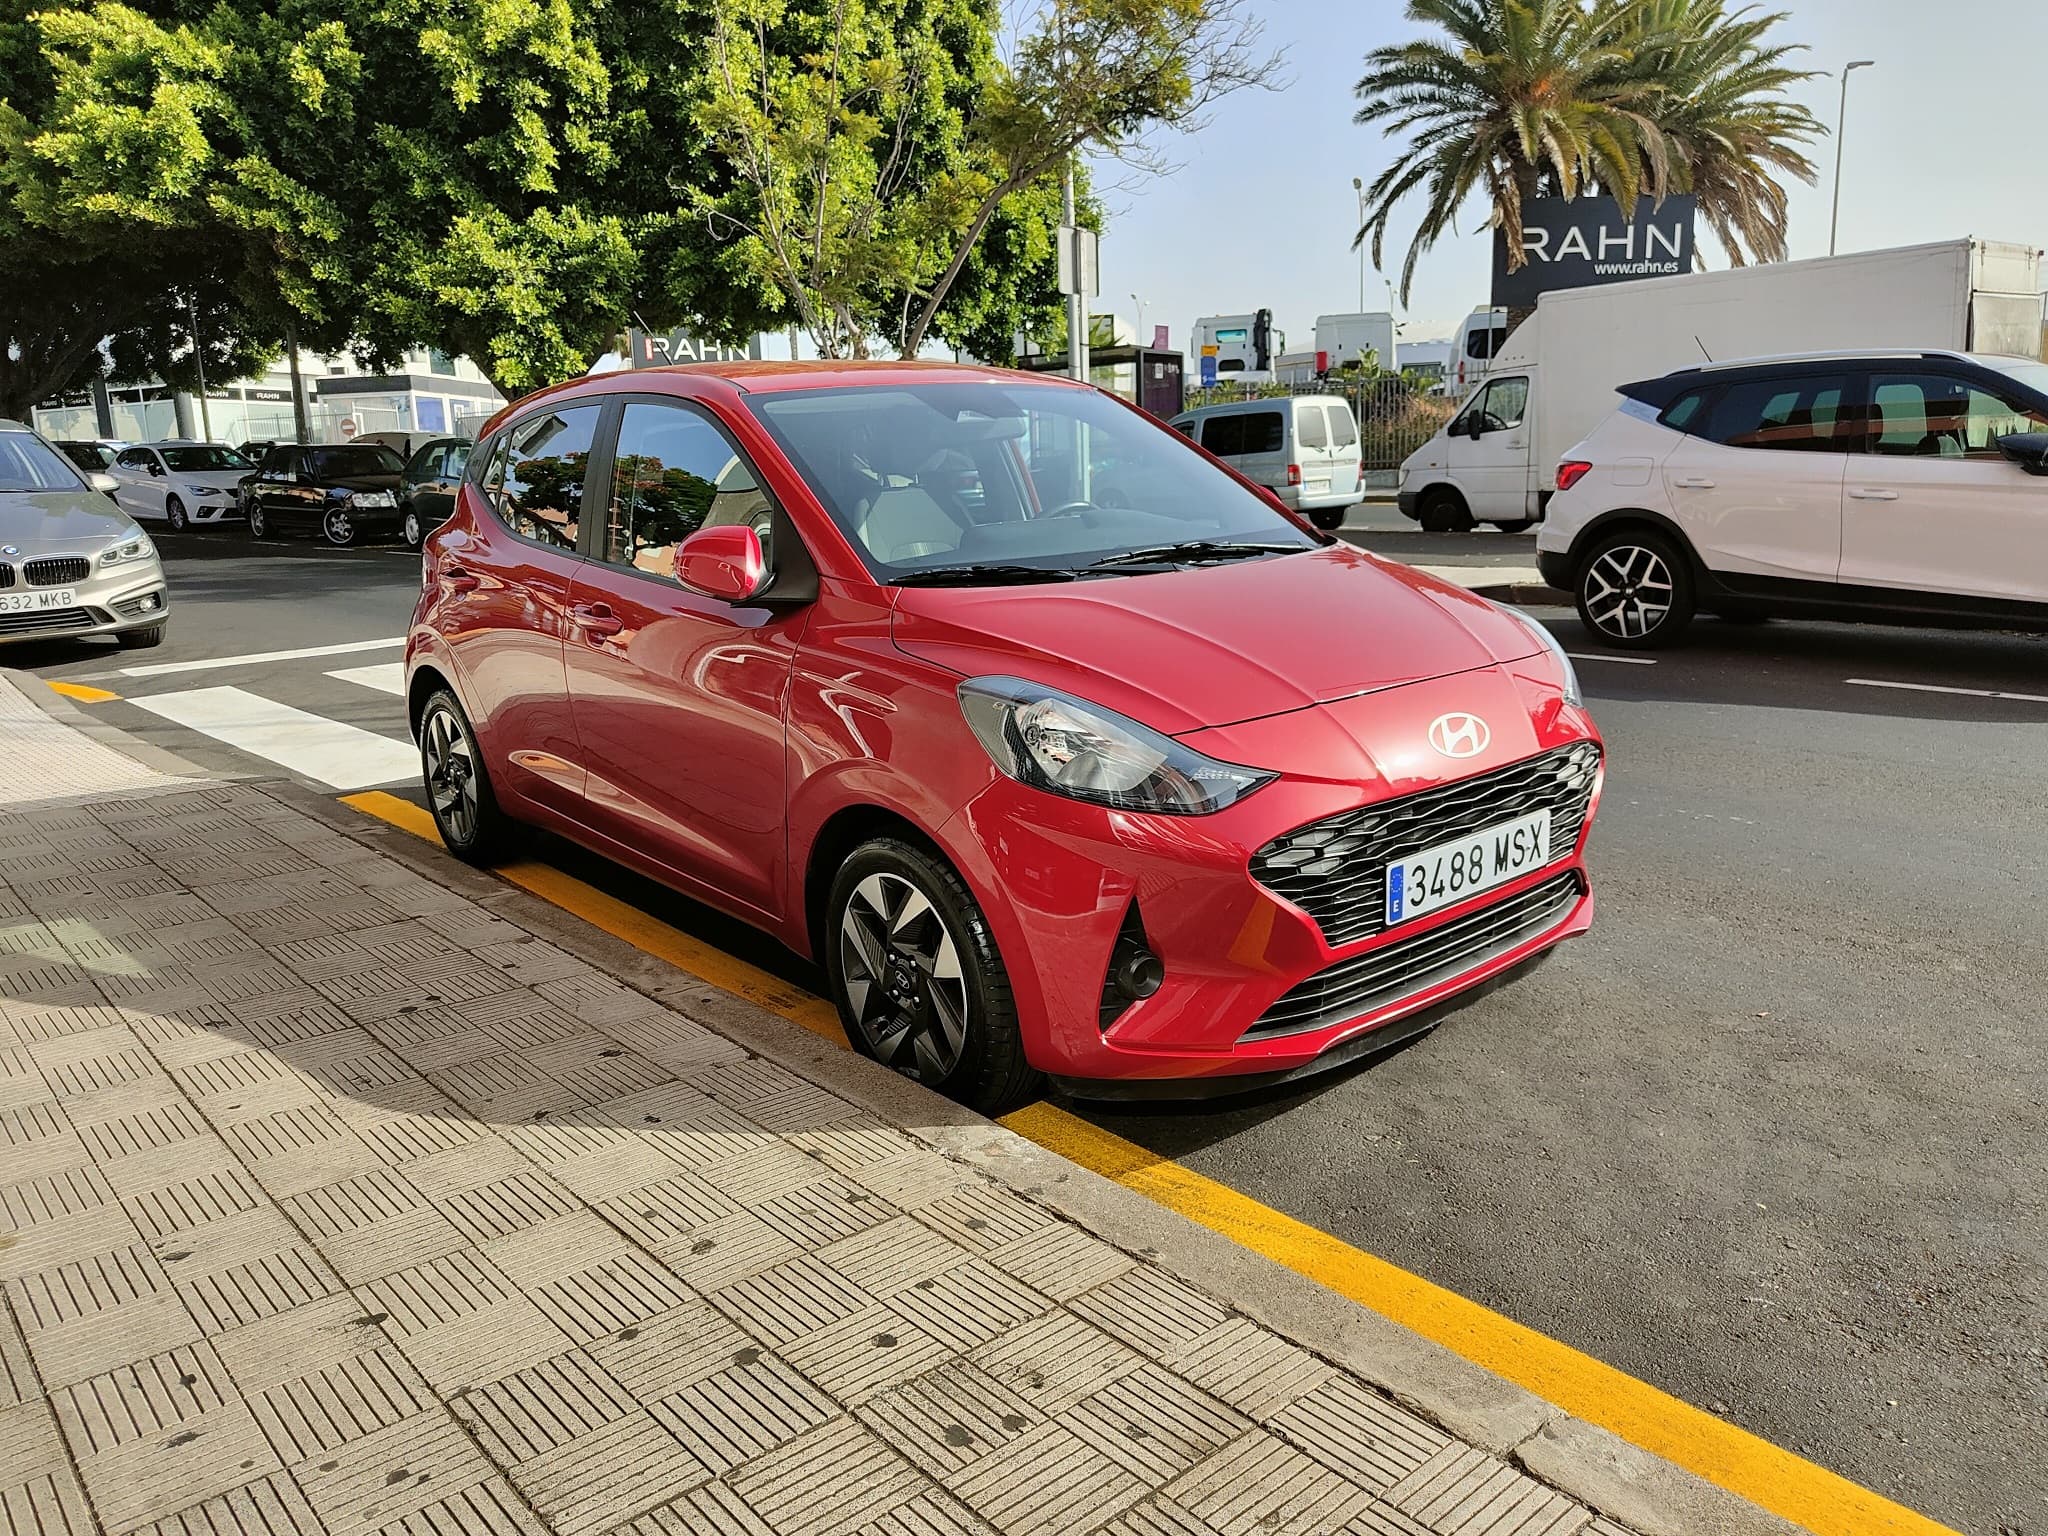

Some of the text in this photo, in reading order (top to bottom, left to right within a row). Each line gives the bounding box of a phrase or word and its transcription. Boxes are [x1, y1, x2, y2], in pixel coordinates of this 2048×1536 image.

[1521, 222, 1682, 262] RAHN
[1594, 259, 1679, 275] www.rahn.es
[256, 392, 280, 400] RAHN
[0, 591, 72, 611] 632 MKB
[1410, 820, 1544, 907] 3488 MSX
[1392, 900, 1400, 913] E
